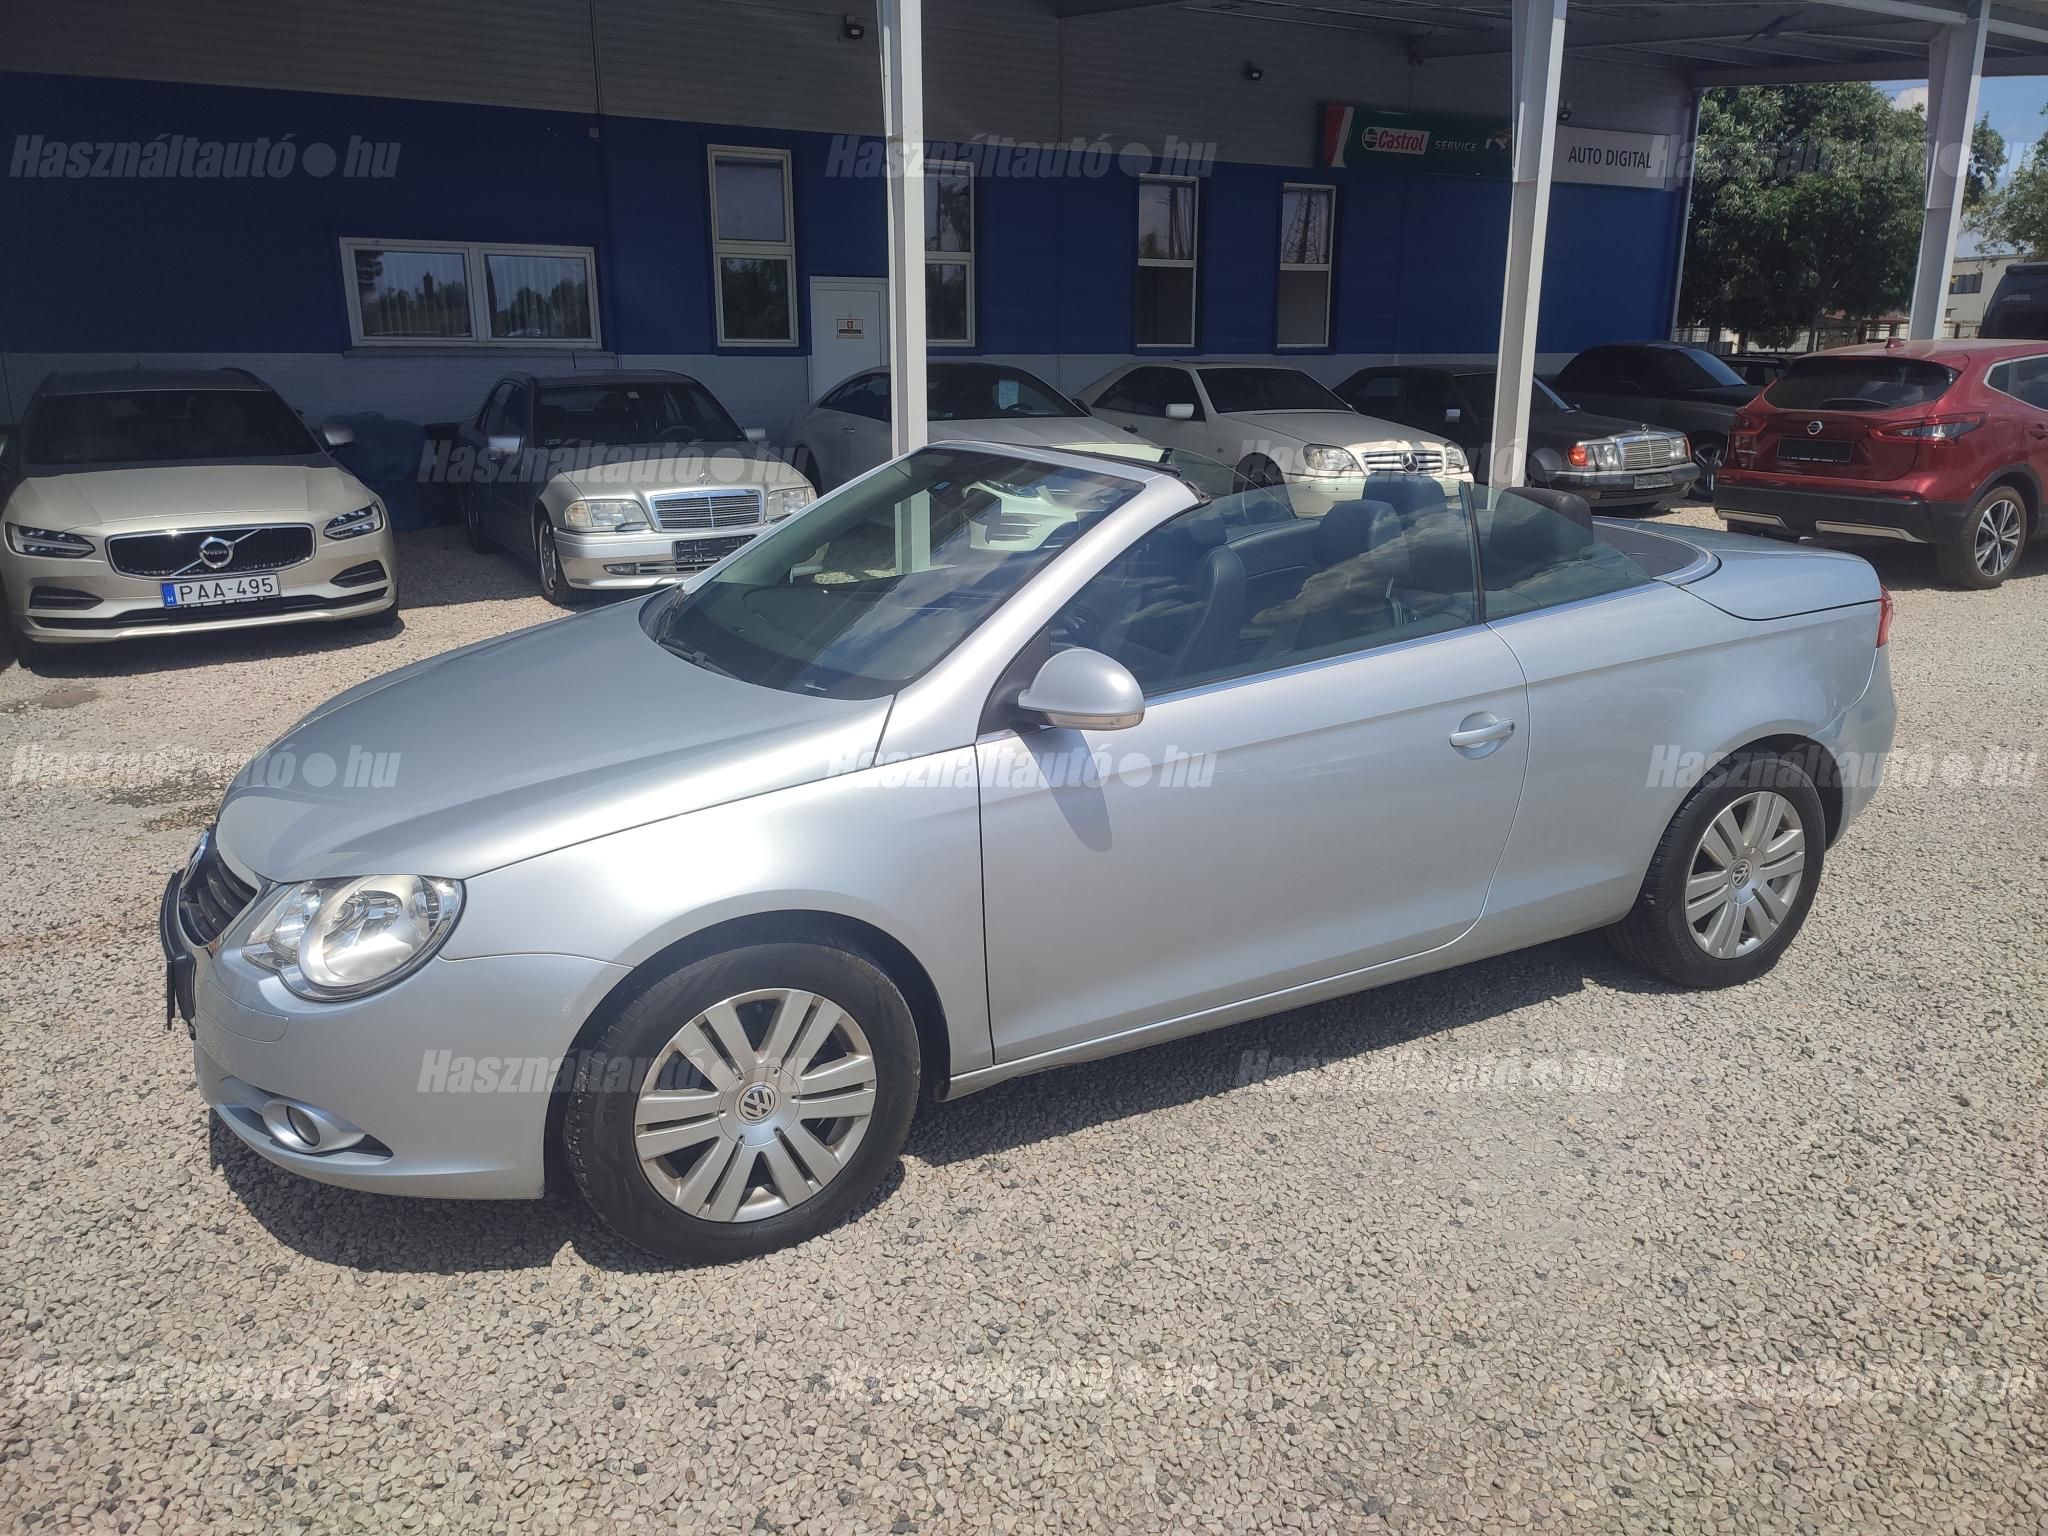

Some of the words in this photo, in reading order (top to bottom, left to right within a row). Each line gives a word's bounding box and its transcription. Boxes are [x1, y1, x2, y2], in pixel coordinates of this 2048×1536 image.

[1377, 130, 1426, 152] Castrol
[1434, 139, 1478, 152] SERVICE
[1568, 145, 1602, 165] AUTO
[1605, 149, 1652, 170] DIGITAL
[179, 577, 274, 602] PAA-495
